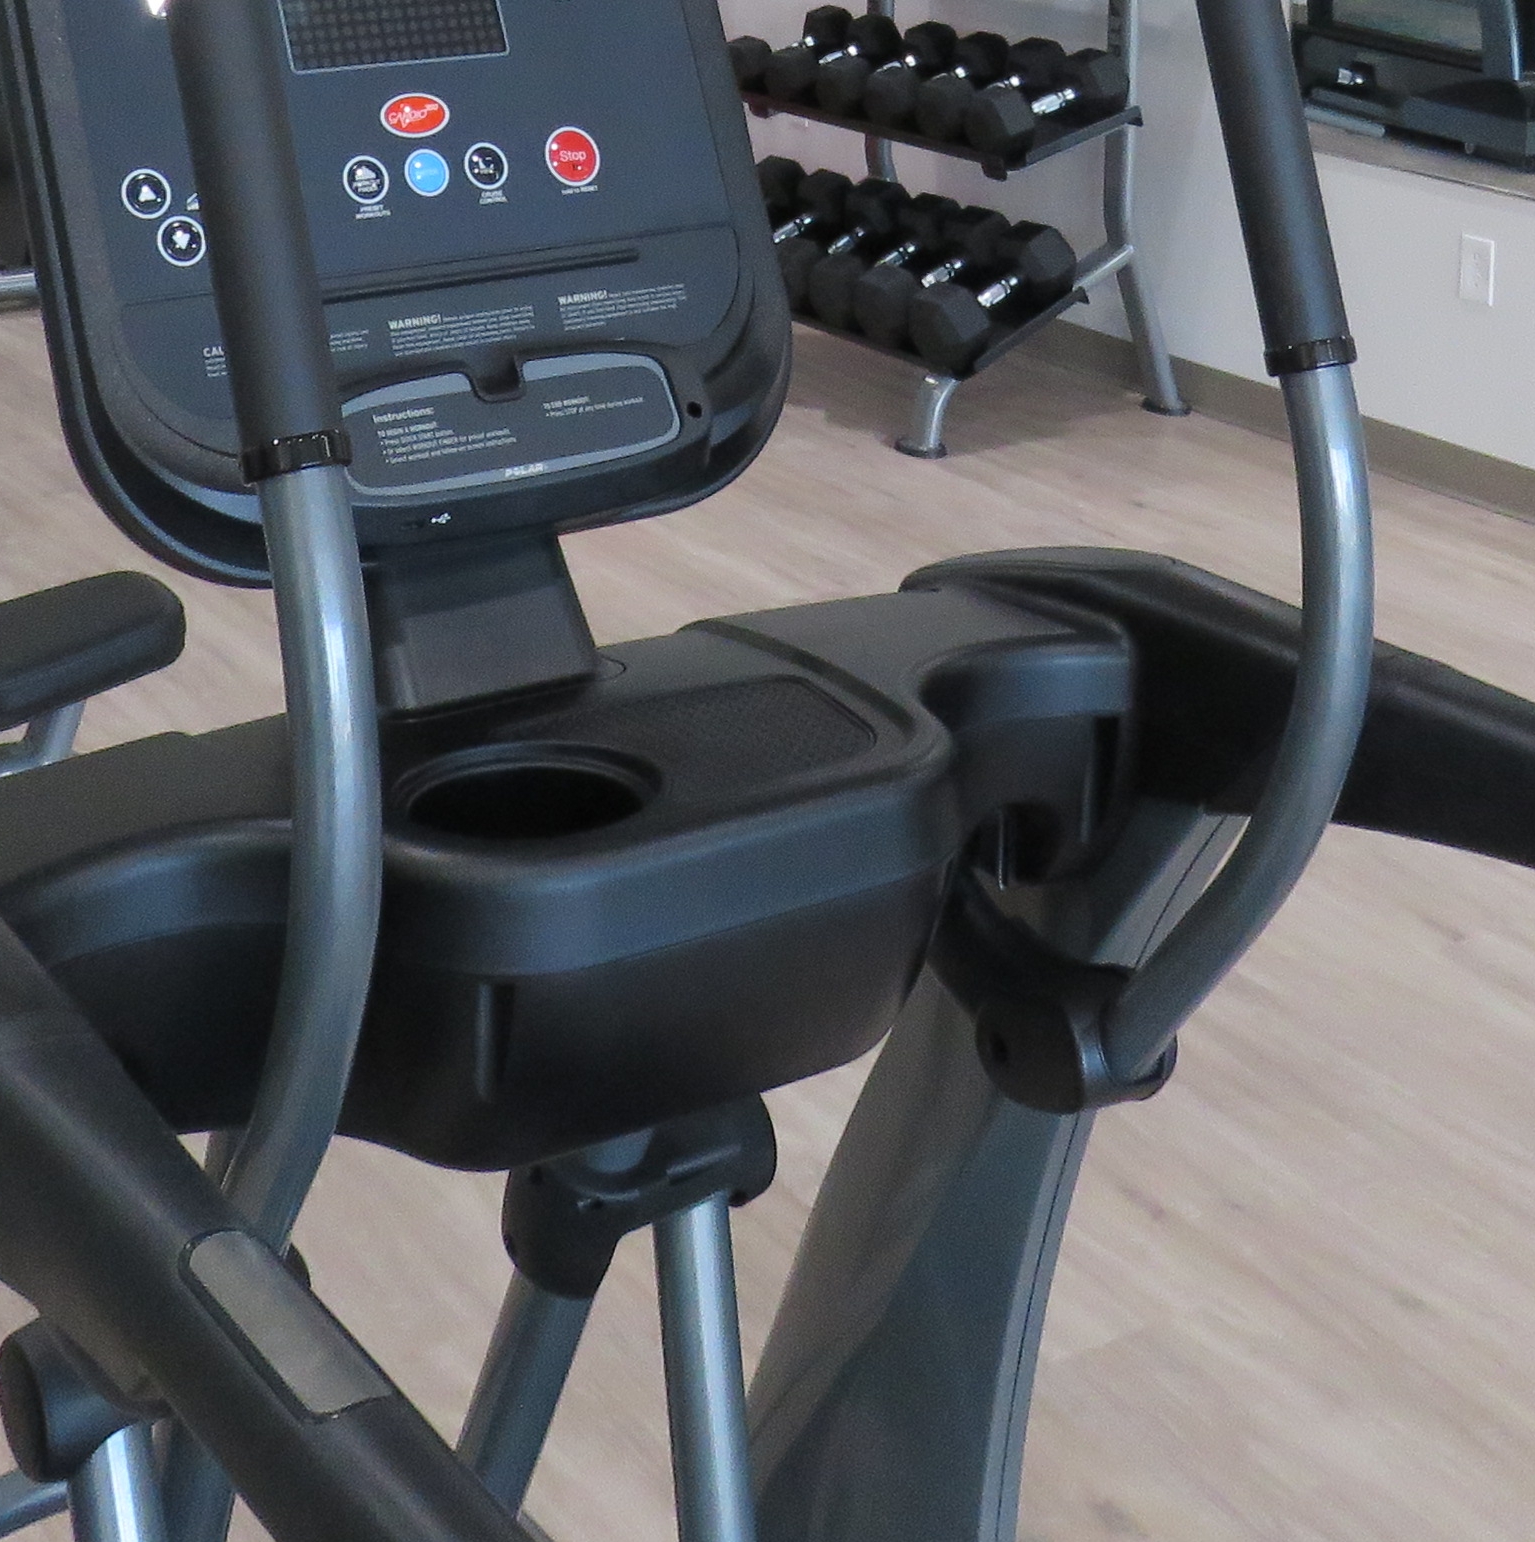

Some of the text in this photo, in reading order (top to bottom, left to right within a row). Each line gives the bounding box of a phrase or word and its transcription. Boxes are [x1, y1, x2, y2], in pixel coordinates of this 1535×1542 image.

[559, 150, 587, 162] Stop
[558, 289, 608, 305] WARNING!
[388, 314, 442, 330] WARNING!
[373, 407, 435, 424] Instructions:
[504, 463, 544, 477] POLAR
